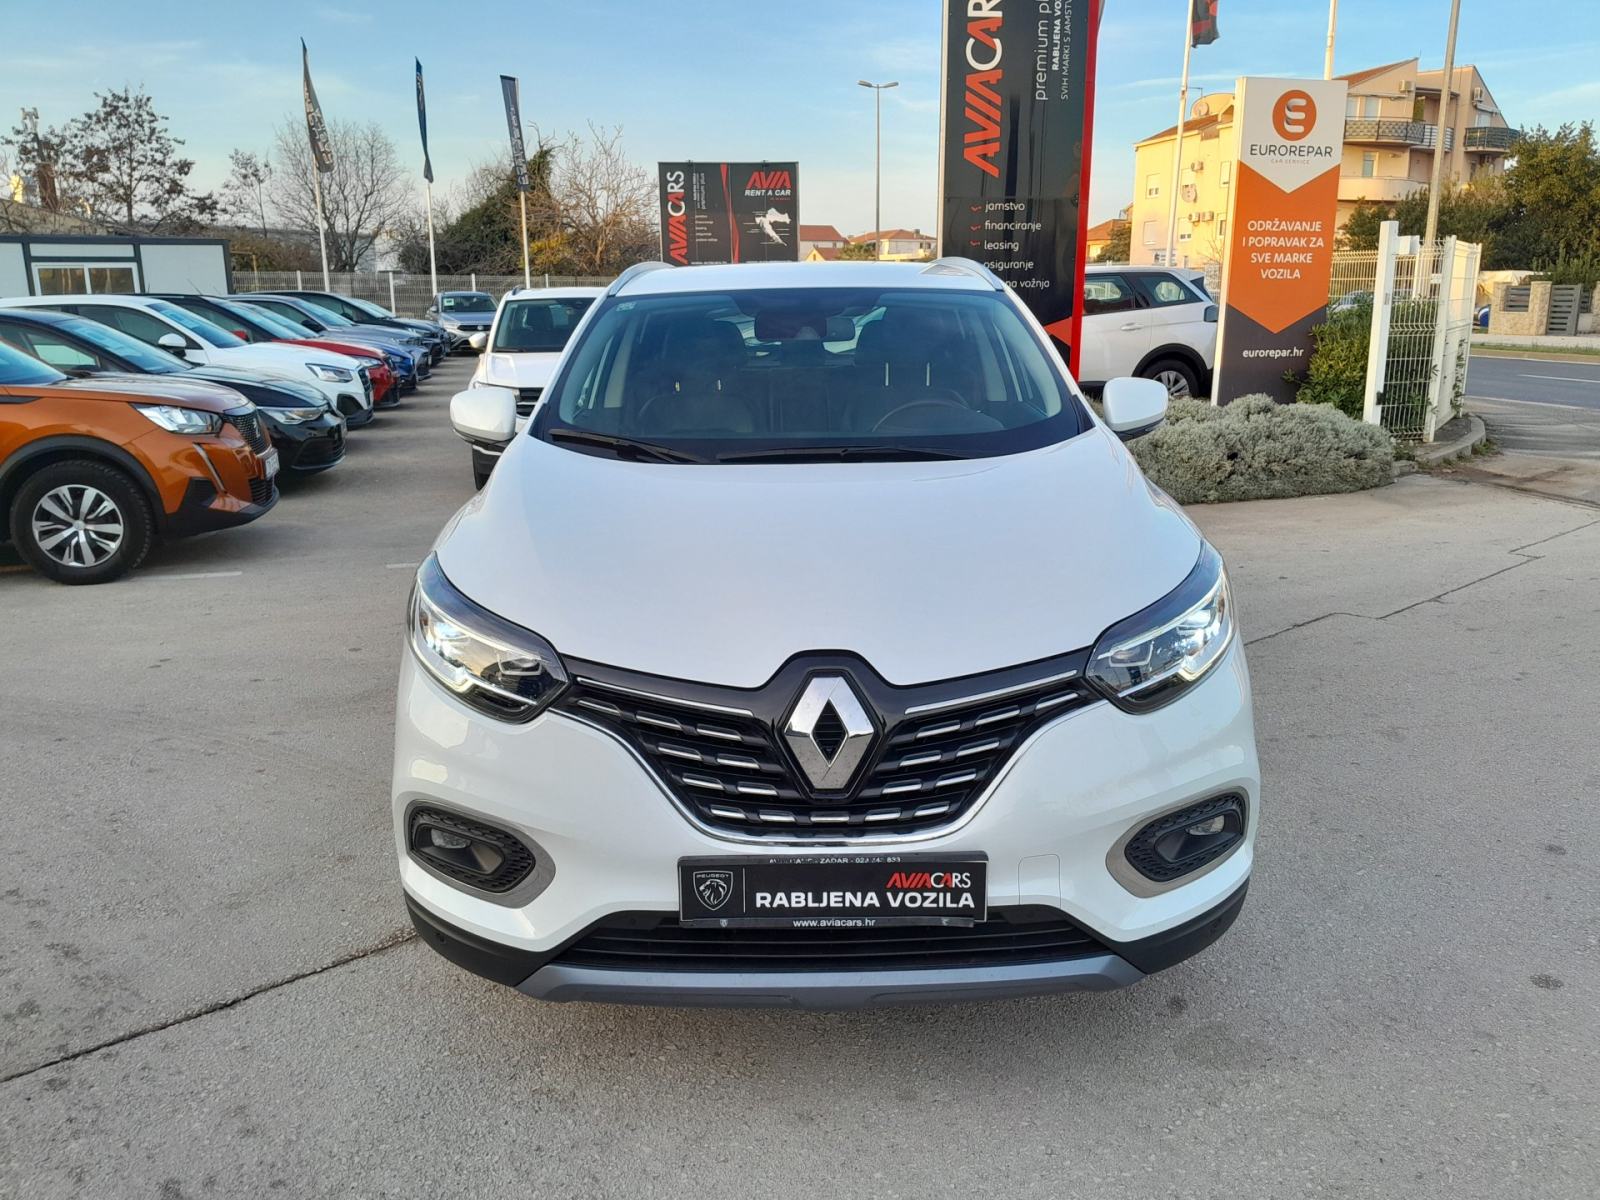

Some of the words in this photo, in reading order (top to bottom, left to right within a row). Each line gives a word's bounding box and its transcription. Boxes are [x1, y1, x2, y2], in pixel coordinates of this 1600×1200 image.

[1053, 0, 1062, 17] VO
[1052, 19, 1062, 71] RABLJENA
[1034, 20, 1048, 100] premium
[1062, 45, 1071, 75] MARKI
[1061, 78, 1069, 100] SVIH
[1250, 144, 1333, 158] EUROREPAR
[746, 171, 792, 189] AVIA
[985, 201, 1025, 212] jamstvo
[666, 171, 688, 265] AVIACARS
[1247, 218, 1322, 232] ODRŽAVANJE
[984, 221, 1042, 232] financiranje
[984, 239, 1019, 252] leasing
[1242, 237, 1246, 247] I
[1248, 236, 1308, 248] POPRAVAK
[1310, 237, 1324, 248] ZA
[984, 260, 1034, 271] osiguranje
[1250, 253, 1272, 263] SVE
[1274, 253, 1313, 264] MARKE
[1261, 269, 1301, 280] VOZILA
[1020, 277, 1050, 290] vožnja
[1242, 346, 1304, 359] eurorepar.hr
[886, 872, 971, 889] AVIACARS
[756, 891, 880, 909] RABLJENA
[886, 891, 975, 909] VOZILA
[793, 918, 876, 928] www.aviacars.hr
